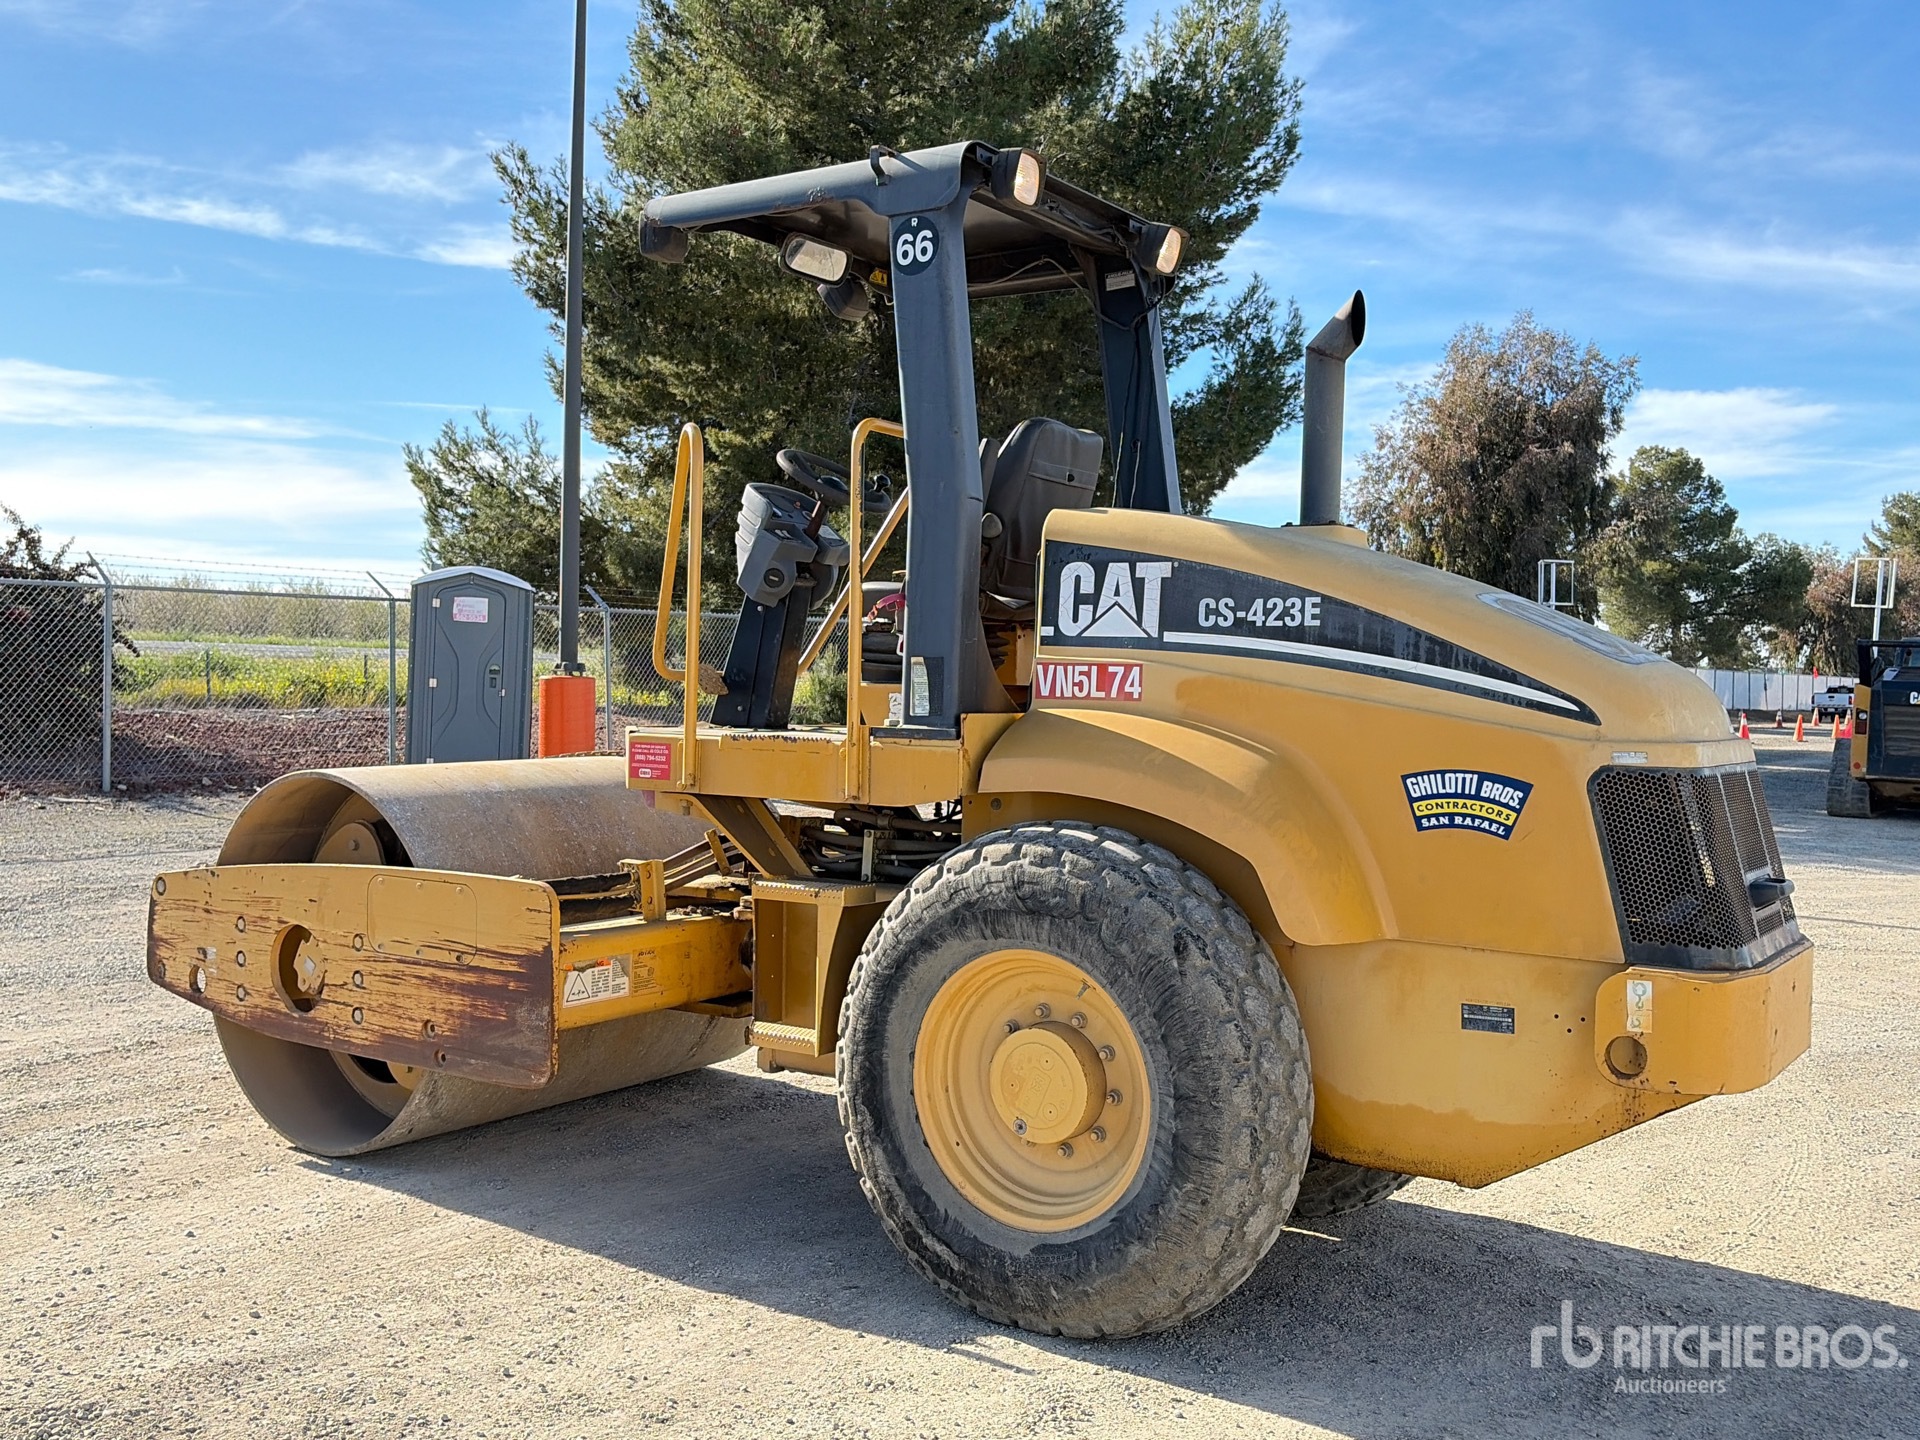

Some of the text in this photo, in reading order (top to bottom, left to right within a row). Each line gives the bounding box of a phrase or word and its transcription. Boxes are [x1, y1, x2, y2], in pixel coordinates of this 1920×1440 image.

[911, 217, 919, 227] R
[896, 229, 934, 266] 66
[1057, 561, 1172, 638] CAT
[1198, 596, 1321, 628] CS-423E
[1036, 665, 1142, 699] VN5L74
[1406, 773, 1524, 809] GHILOTTI BROS.
[1416, 801, 1512, 821] CONTRACTORS
[1421, 816, 1506, 836] SAN RAFAEL
